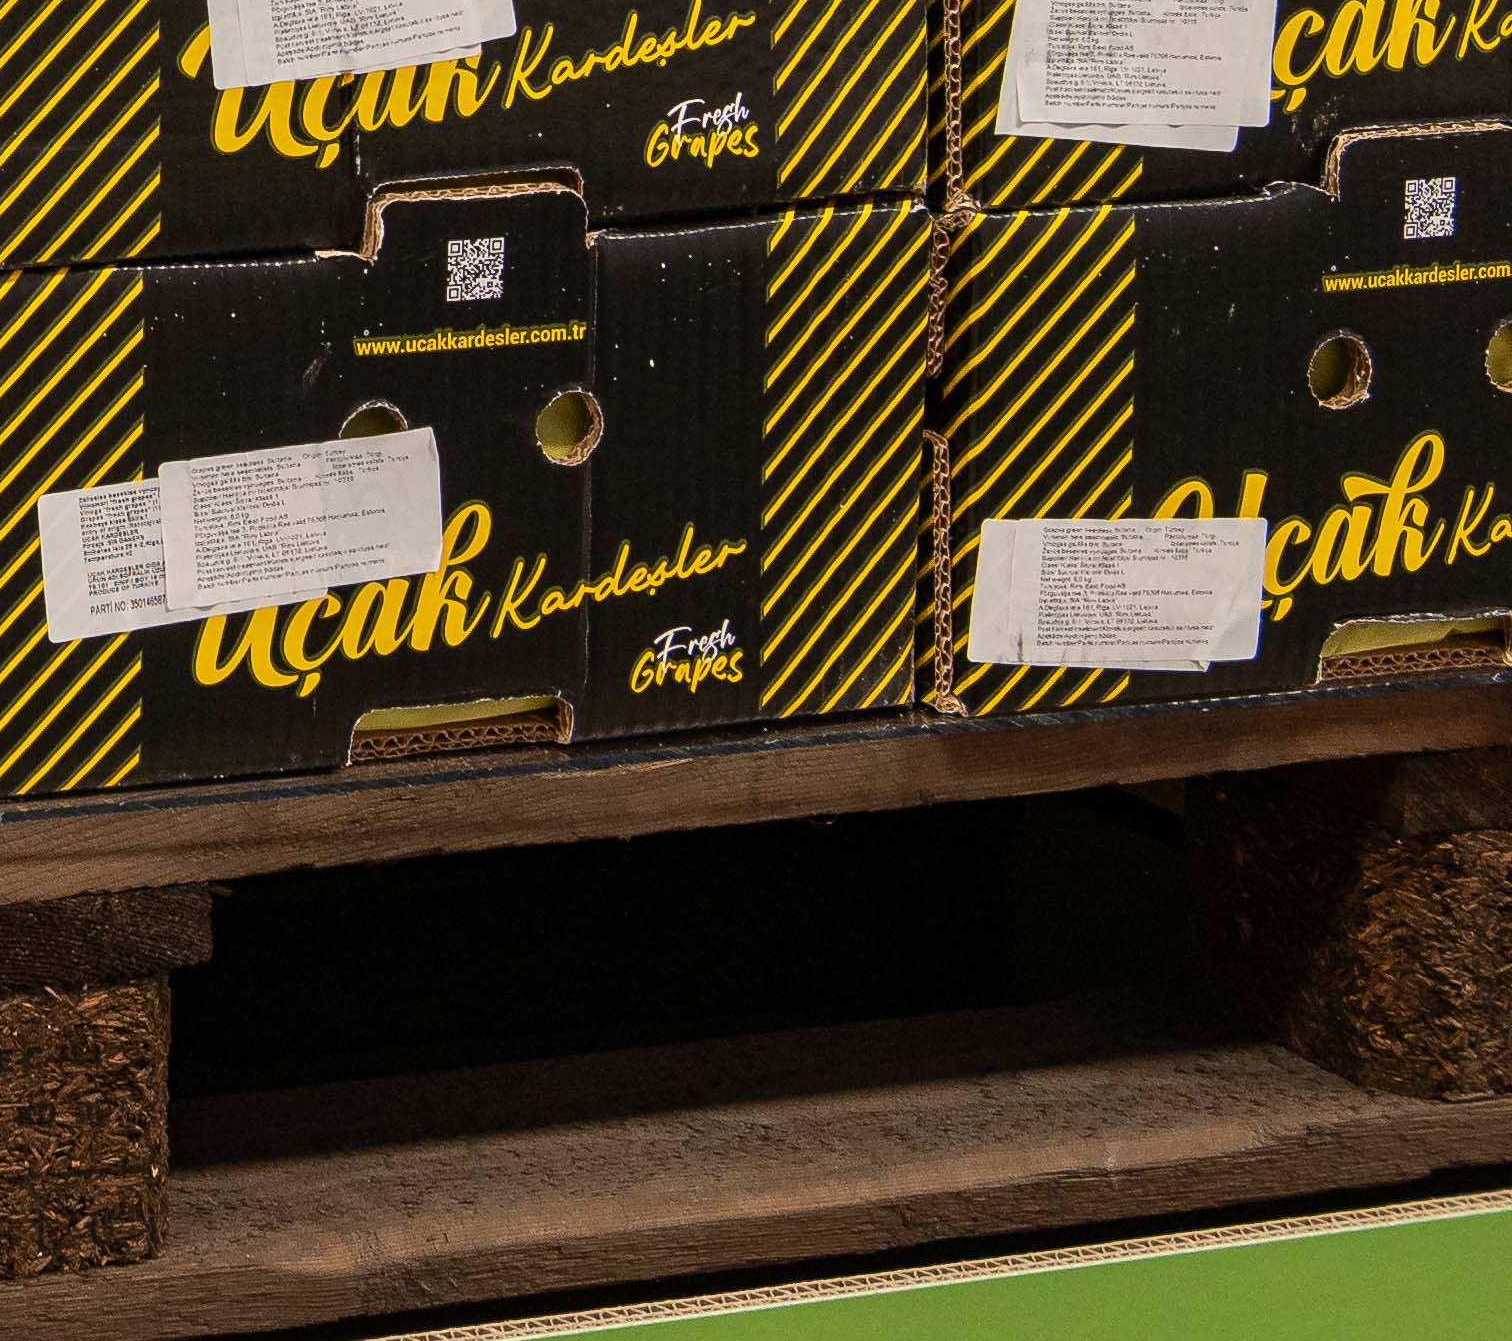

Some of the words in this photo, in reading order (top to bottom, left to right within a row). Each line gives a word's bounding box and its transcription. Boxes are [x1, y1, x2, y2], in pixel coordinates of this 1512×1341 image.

[666, 93, 749, 135] Fresh
[645, 121, 759, 169] Grapes
[354, 323, 586, 358] www.ucakkardesler.com.tr
[492, 523, 747, 638] Kardeşler
[653, 619, 736, 660] Fresh
[630, 649, 744, 694] Grapes
